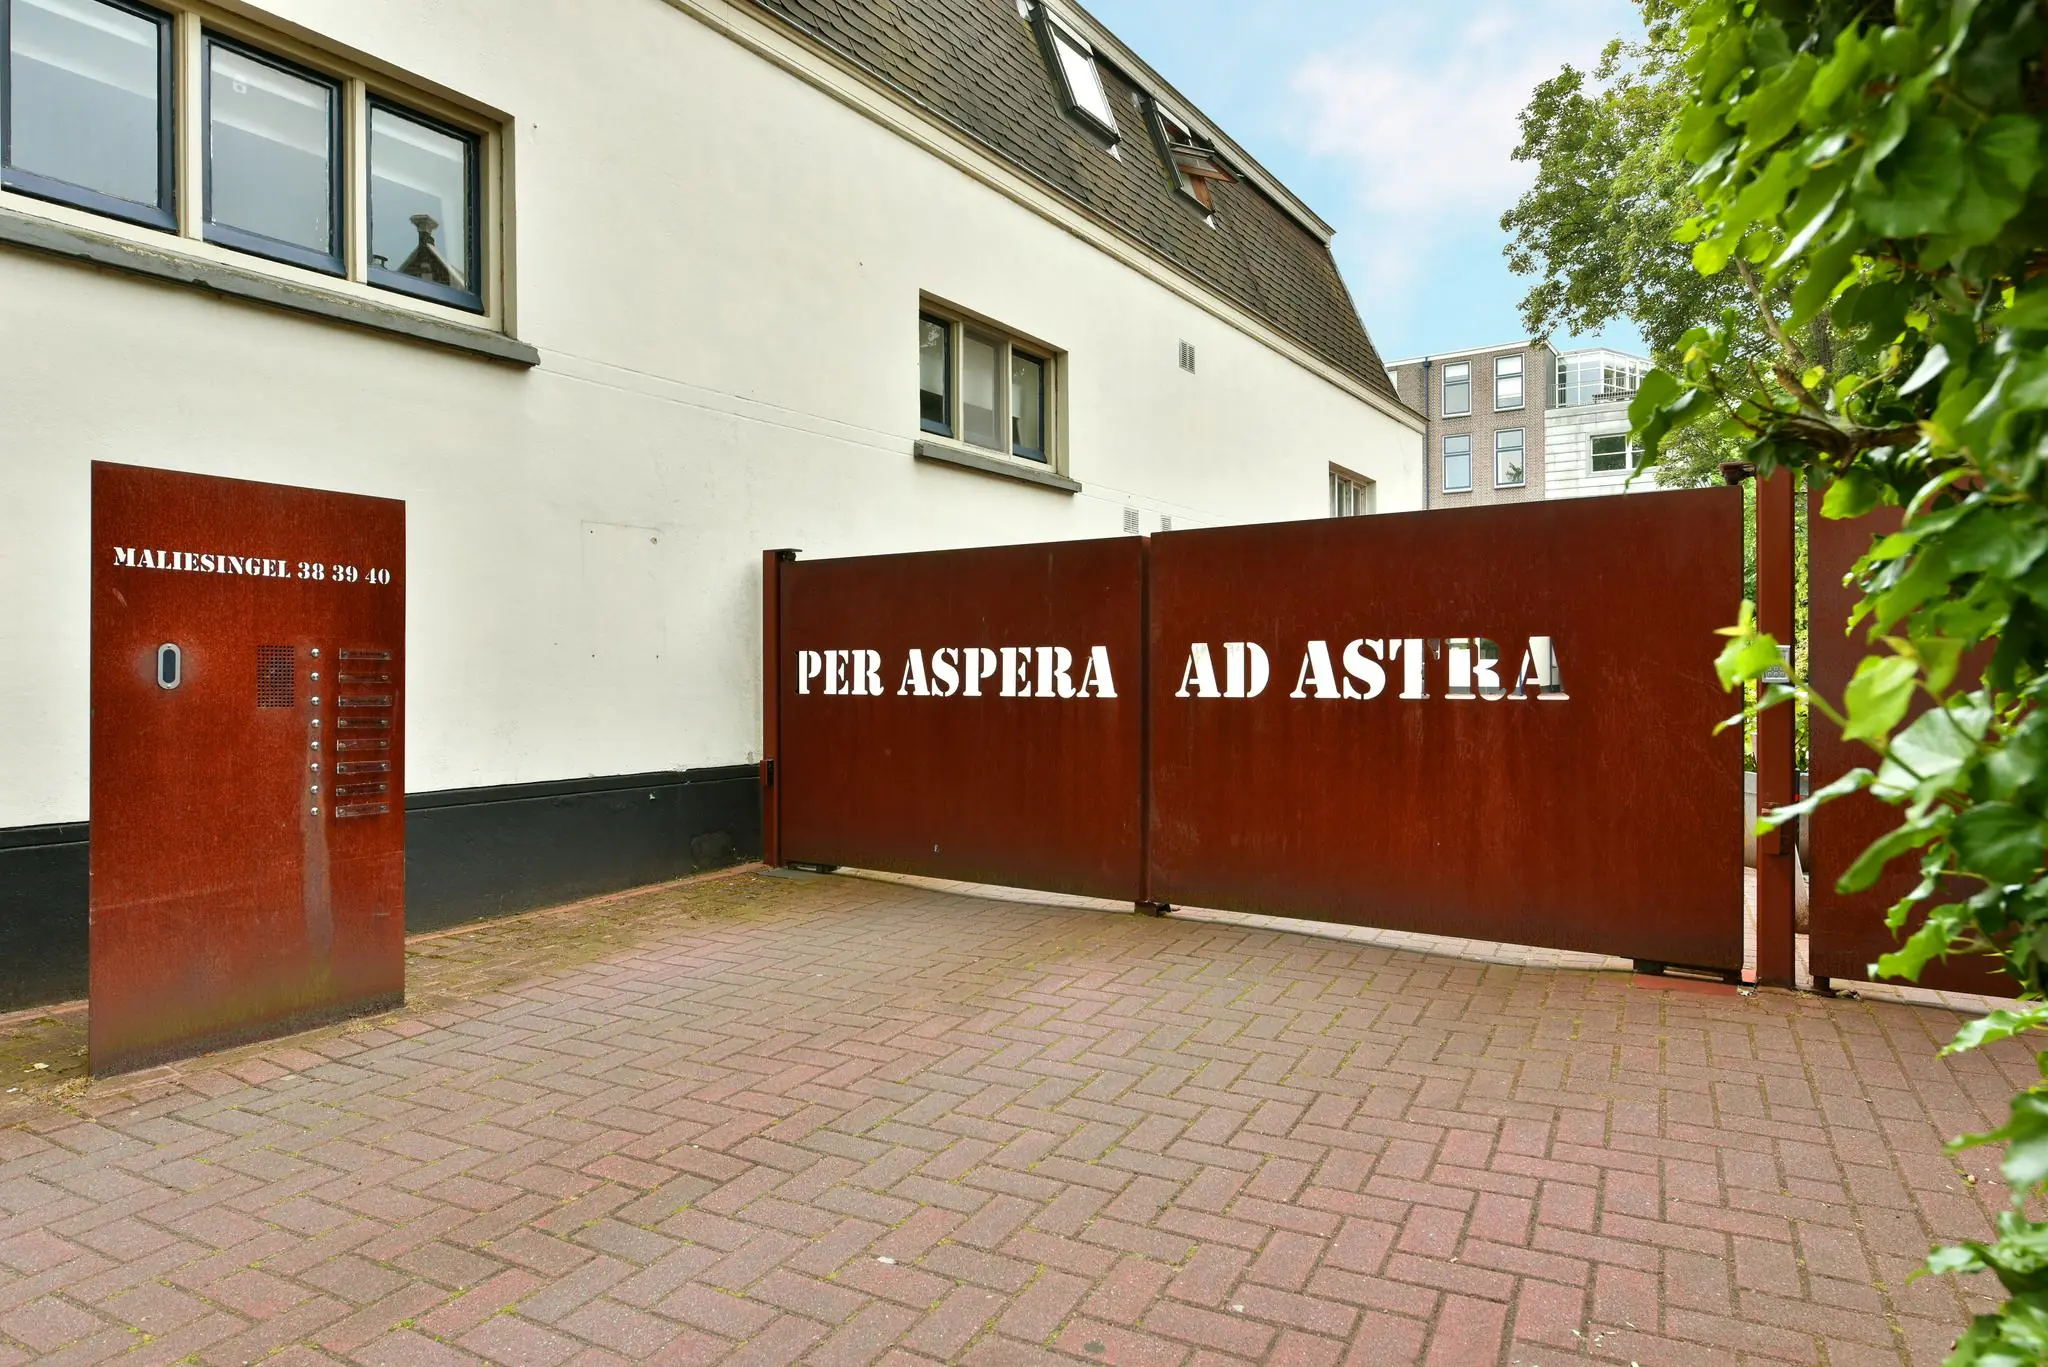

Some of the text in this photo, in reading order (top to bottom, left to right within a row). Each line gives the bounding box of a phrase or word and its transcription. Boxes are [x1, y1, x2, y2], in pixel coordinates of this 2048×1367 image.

[113, 546, 391, 585] MALIESINGEL 38 39 40
[797, 635, 1571, 702] PER ASPERA AD ASTRA
